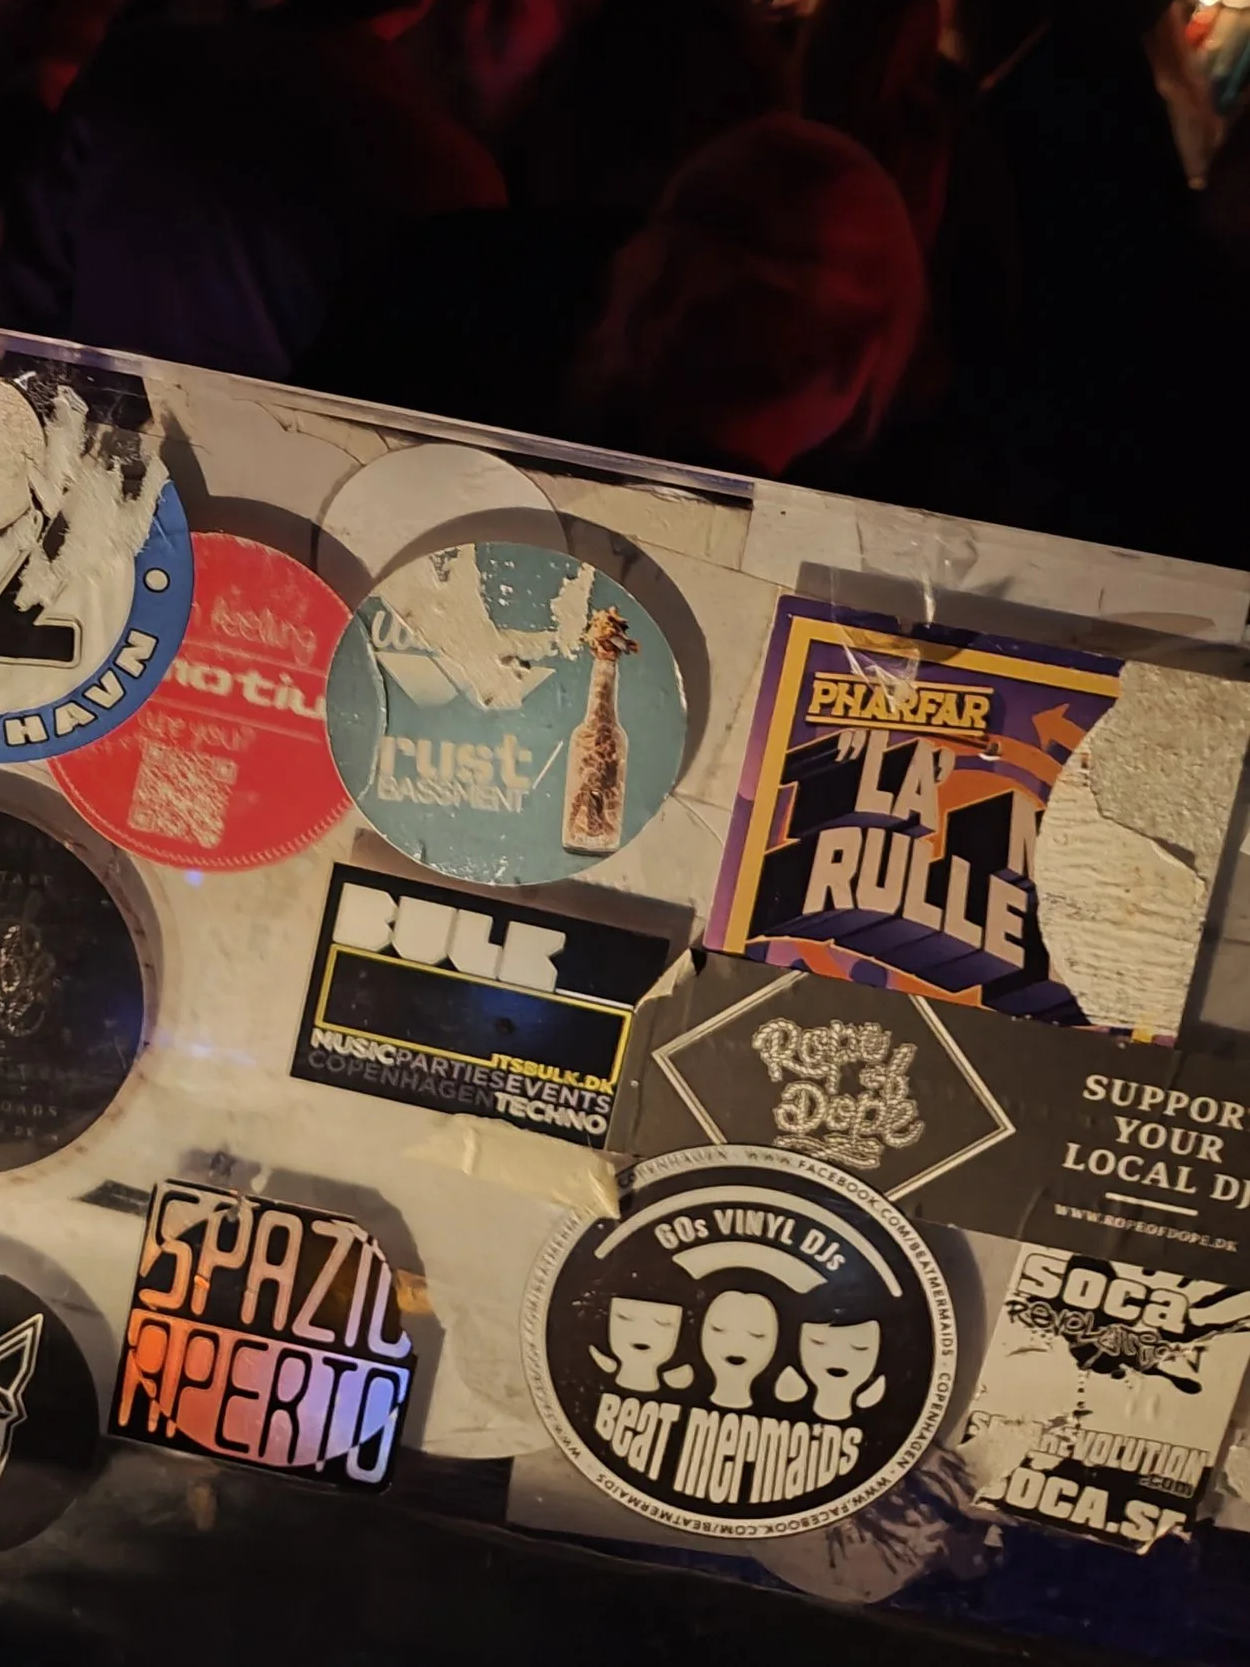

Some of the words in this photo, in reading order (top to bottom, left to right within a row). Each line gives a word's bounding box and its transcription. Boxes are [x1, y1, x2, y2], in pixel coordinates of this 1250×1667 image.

[808, 680, 990, 729] PHARFAR
[380, 734, 533, 790] rust
[802, 827, 1028, 969] RULLE
[332, 881, 566, 992] BULK
[1082, 1074, 1250, 1132] SUPPOR
[1062, 1142, 1197, 1194] LOCAL
[1114, 1115, 1225, 1163] YOUR
[654, 1215, 710, 1250] 60s
[712, 1209, 796, 1246] VINYL
[798, 1228, 847, 1272] DJs
[118, 1317, 410, 1485] APERTO
